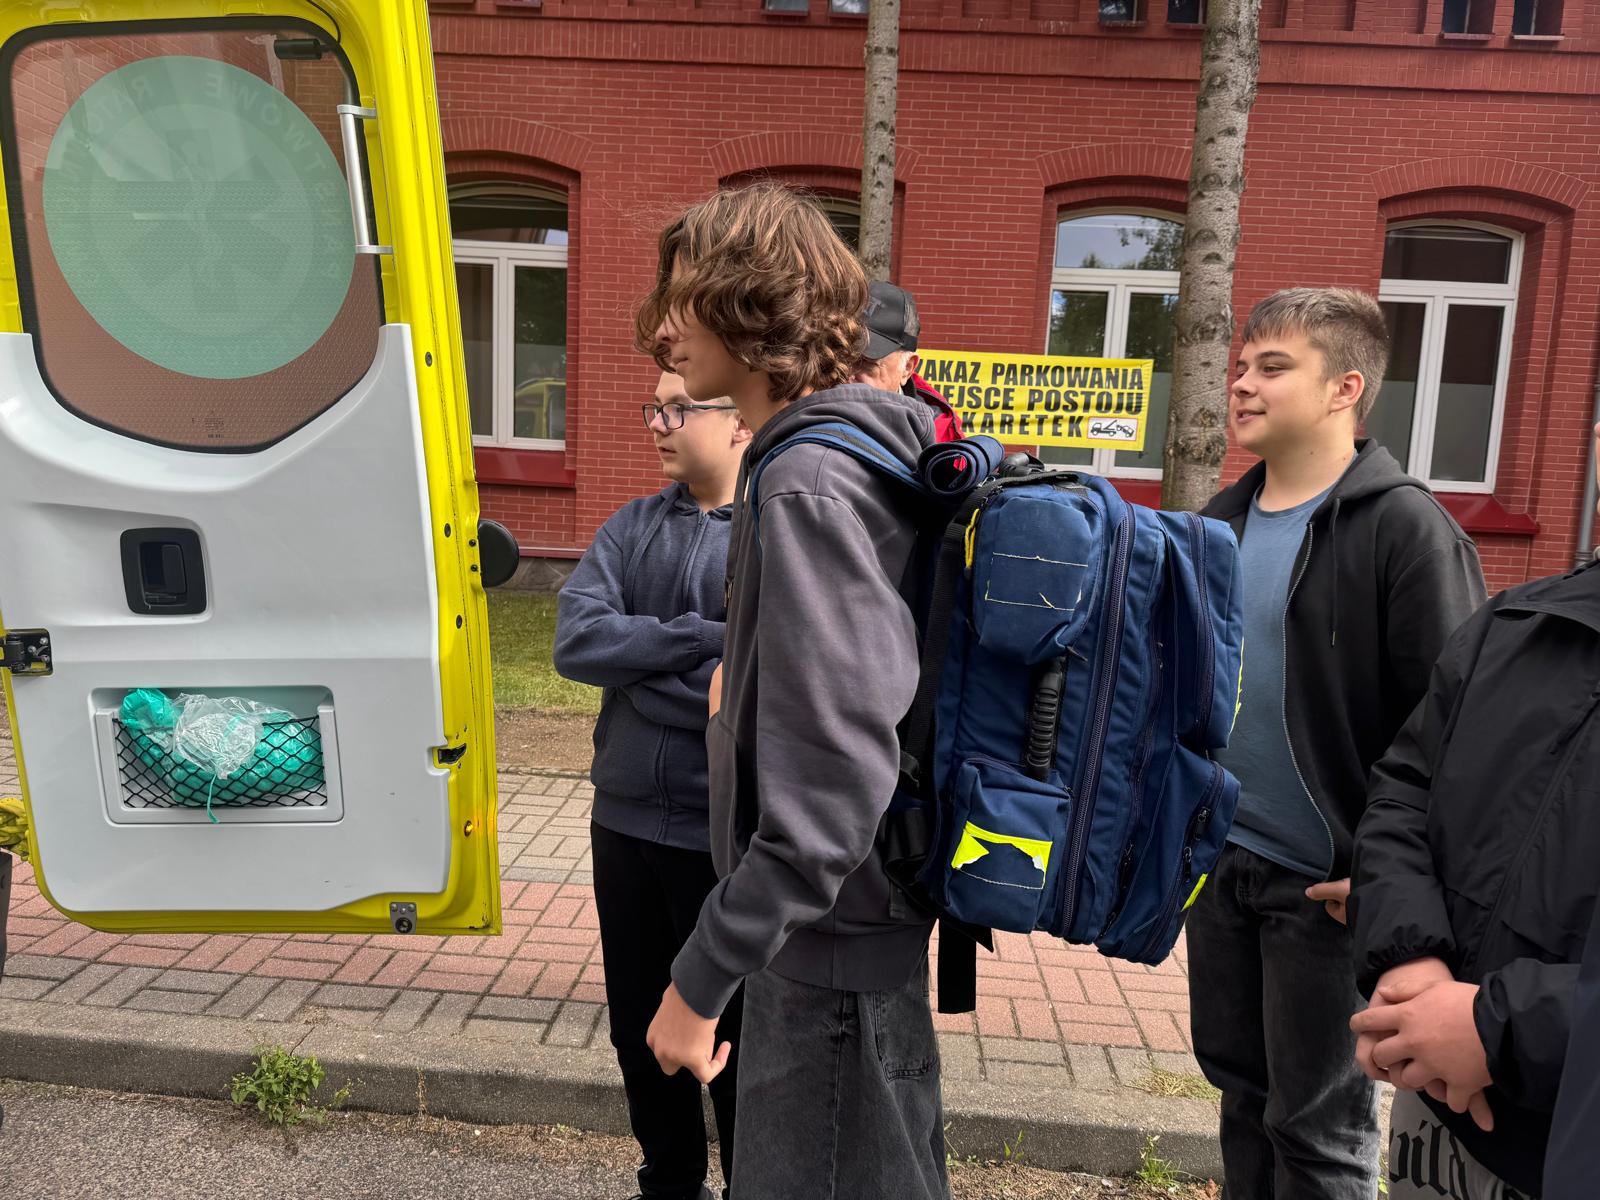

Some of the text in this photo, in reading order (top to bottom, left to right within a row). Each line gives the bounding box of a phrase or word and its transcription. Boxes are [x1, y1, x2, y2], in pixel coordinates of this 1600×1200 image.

[991, 362, 1144, 390] PARKOWANIA
[933, 384, 1144, 416] EJSCE POSTOJU
[961, 411, 1084, 438] KARETEK
